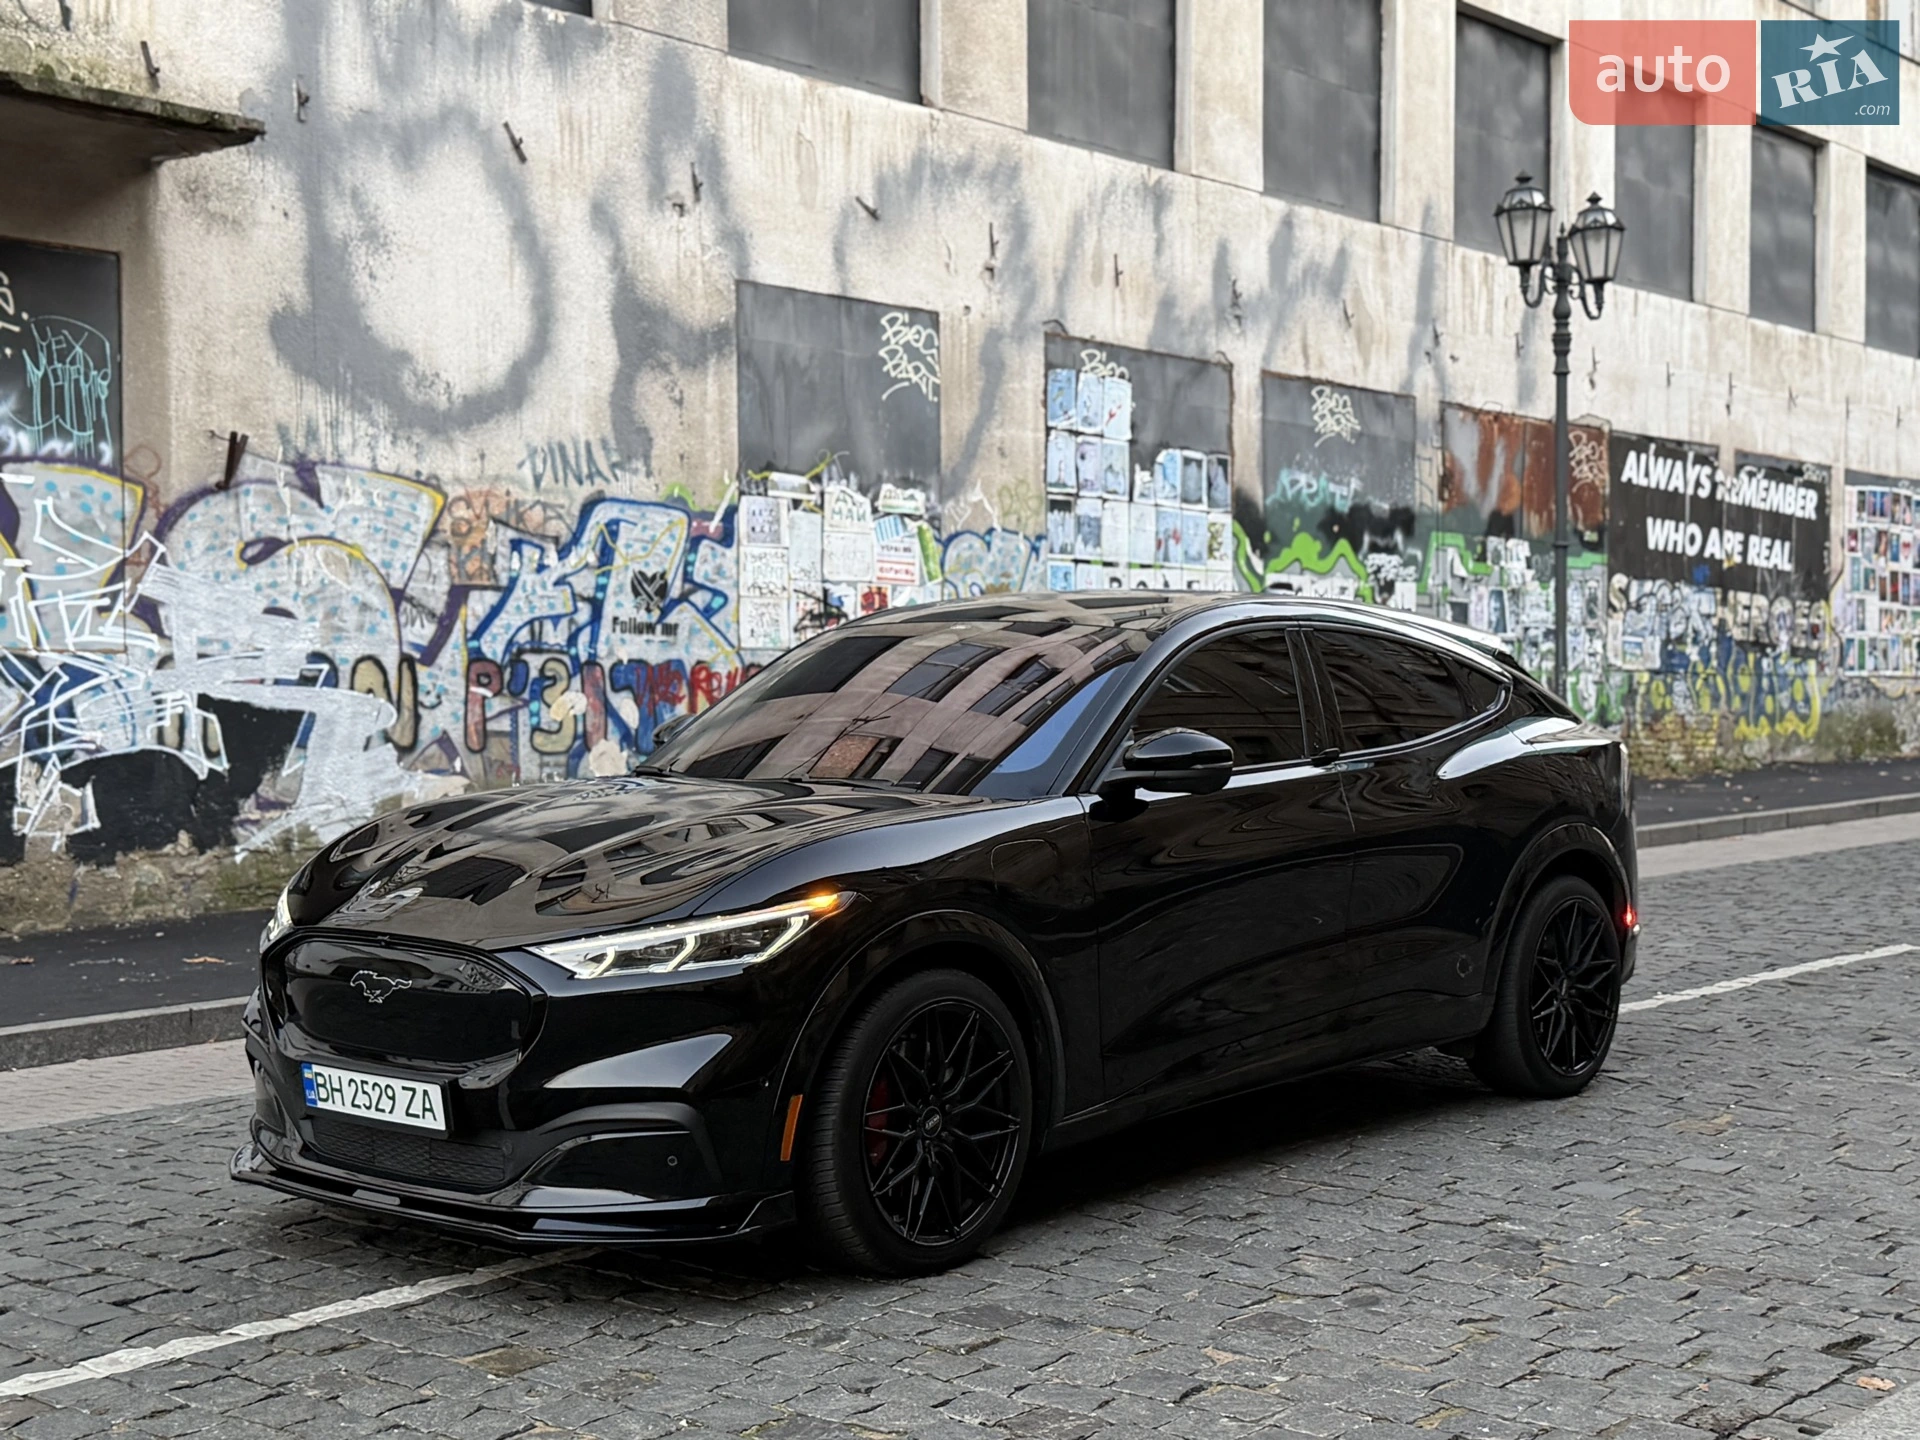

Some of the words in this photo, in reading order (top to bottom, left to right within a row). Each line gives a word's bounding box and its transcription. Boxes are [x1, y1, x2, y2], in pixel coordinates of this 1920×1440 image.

[1620, 447, 1713, 499] ALWAYS
[1714, 468, 1819, 521] REMEMBER
[1646, 516, 1703, 557] WHO
[1703, 526, 1745, 564] ARE
[1746, 534, 1793, 572] REAL
[612, 616, 656, 636] Follow
[314, 1071, 346, 1107] BH
[347, 1077, 397, 1115] 2529
[401, 1085, 438, 1122] ZA
